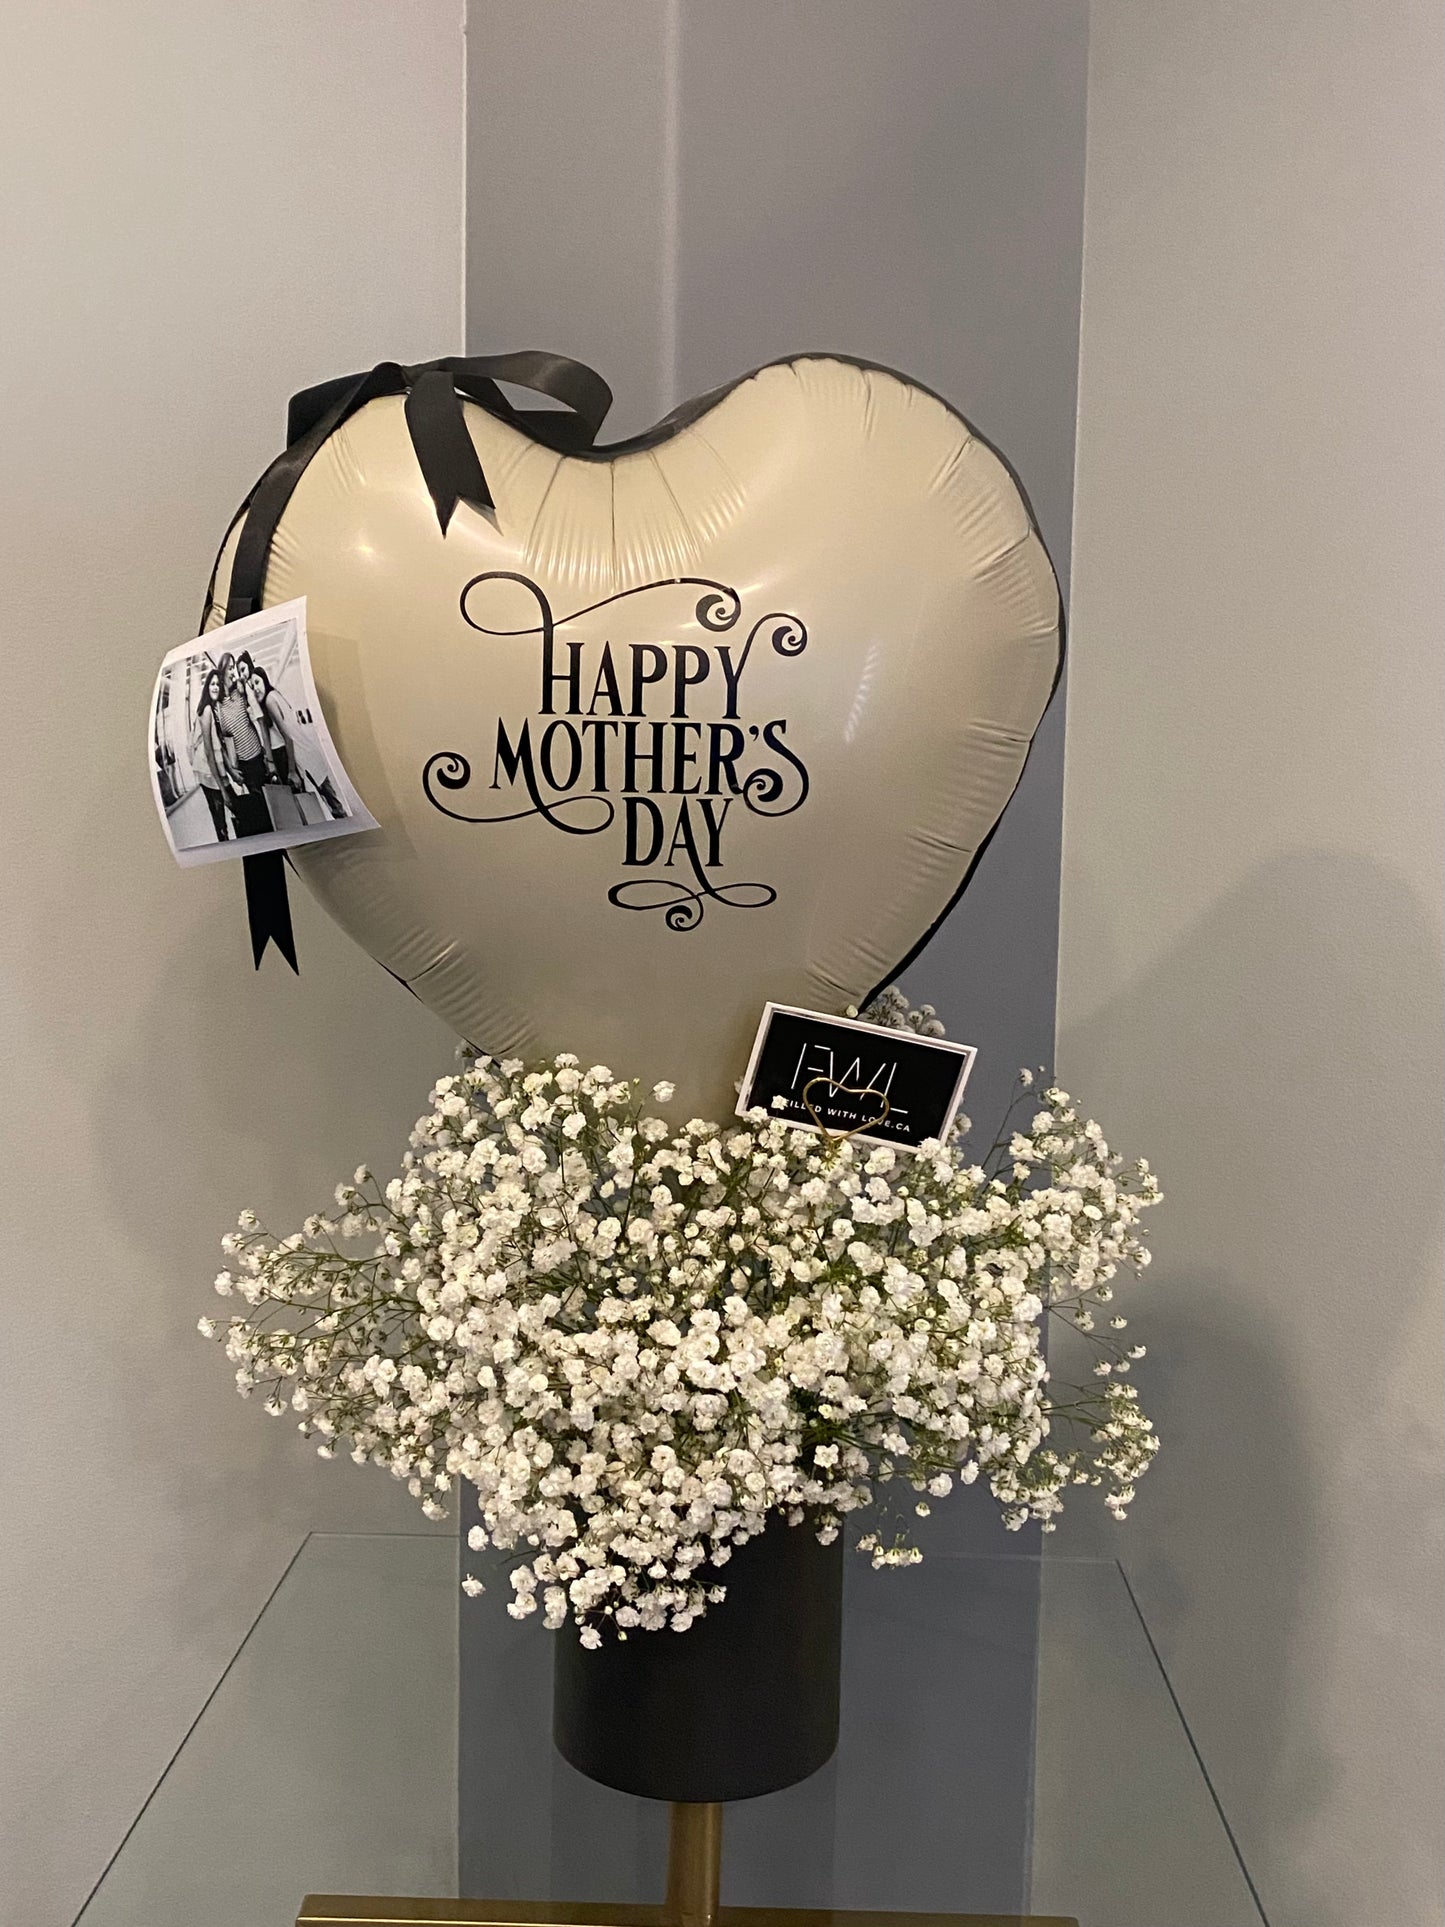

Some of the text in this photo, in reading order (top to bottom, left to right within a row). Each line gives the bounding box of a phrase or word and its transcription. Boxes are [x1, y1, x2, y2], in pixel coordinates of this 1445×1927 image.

[422, 716, 809, 834] MOTHER'S
[785, 1098, 822, 1113] ILLD
[826, 1107, 858, 1120] WITH
